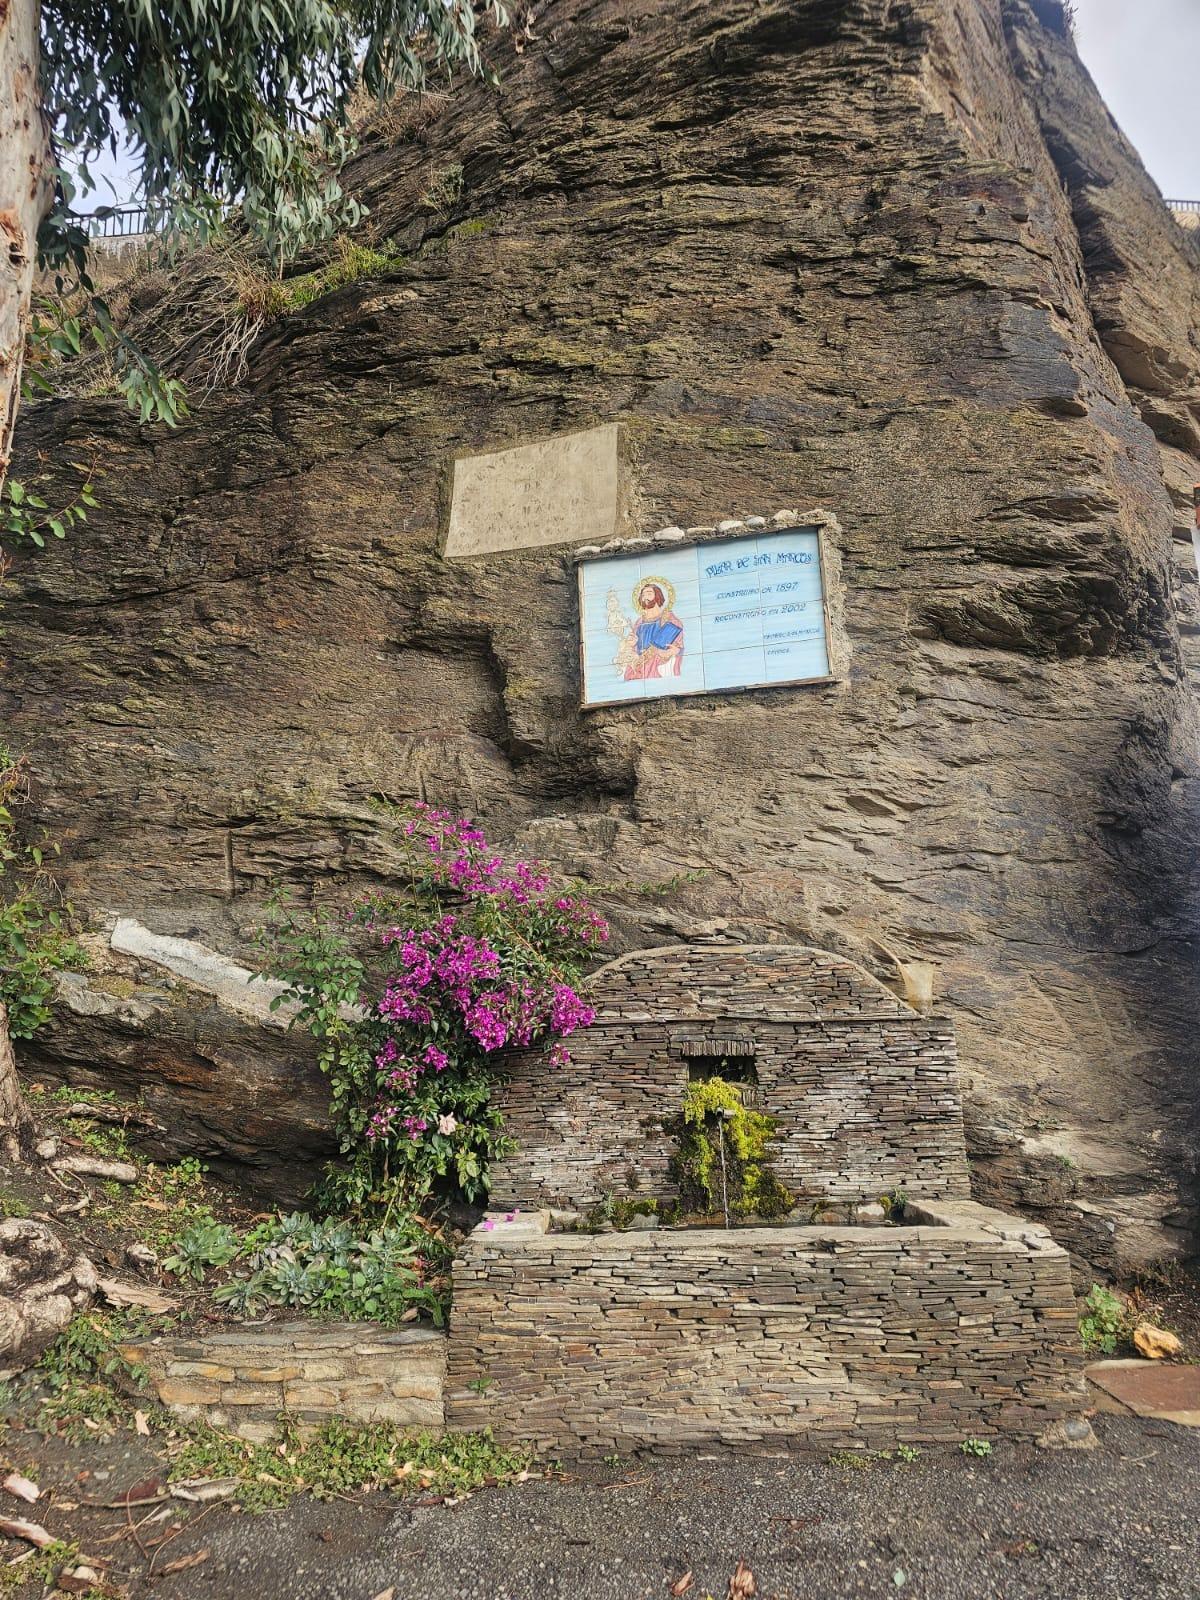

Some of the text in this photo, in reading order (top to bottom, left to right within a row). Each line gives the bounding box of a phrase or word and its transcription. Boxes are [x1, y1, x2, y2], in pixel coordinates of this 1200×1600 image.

[706, 552, 812, 578] PILAR DE SAN MARCOS
[776, 581, 799, 593] 1897
[781, 602, 806, 614] 2002
